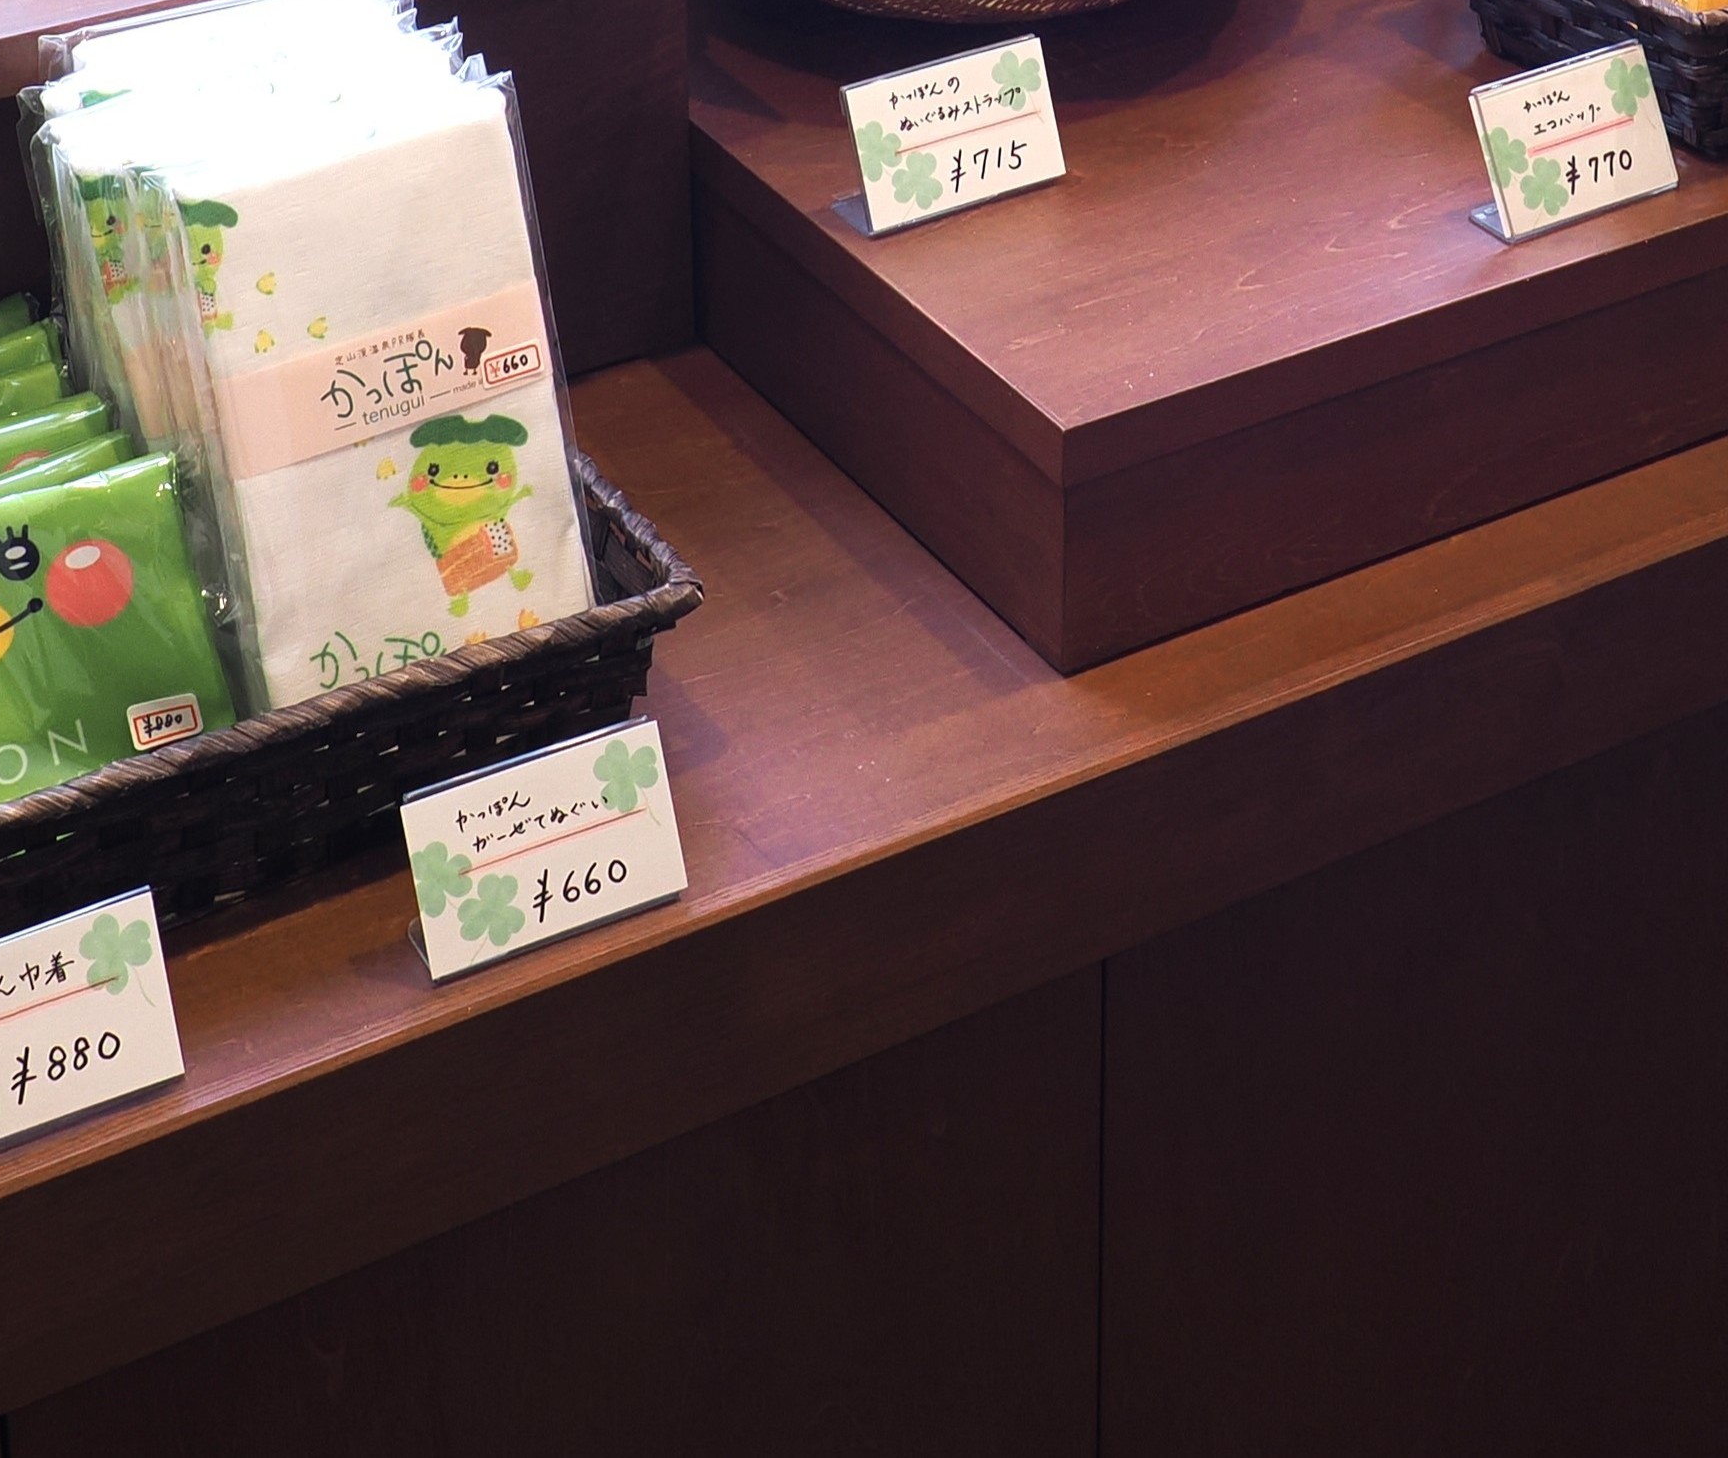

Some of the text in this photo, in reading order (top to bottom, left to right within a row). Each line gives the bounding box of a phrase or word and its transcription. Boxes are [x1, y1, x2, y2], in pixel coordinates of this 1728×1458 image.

[888, 76, 961, 109] かっぽんの
[898, 85, 1023, 133] ぬいぐるみストラップ
[1522, 89, 1571, 115] かっぽん
[1534, 103, 1603, 137] エコバッグ
[949, 140, 1025, 194] ¥715
[1566, 148, 1634, 196] ¥770
[320, 339, 454, 419] かっぽん
[489, 354, 529, 377] ¥660
[362, 379, 478, 426] tenugui made
[309, 630, 448, 689] かっぽ
[142, 713, 183, 739] ¥880
[454, 794, 533, 835] かっぽん
[472, 794, 611, 854] ガーゼてぬぐい
[533, 857, 629, 923] ¥660
[11, 1030, 122, 1106] ¥880
